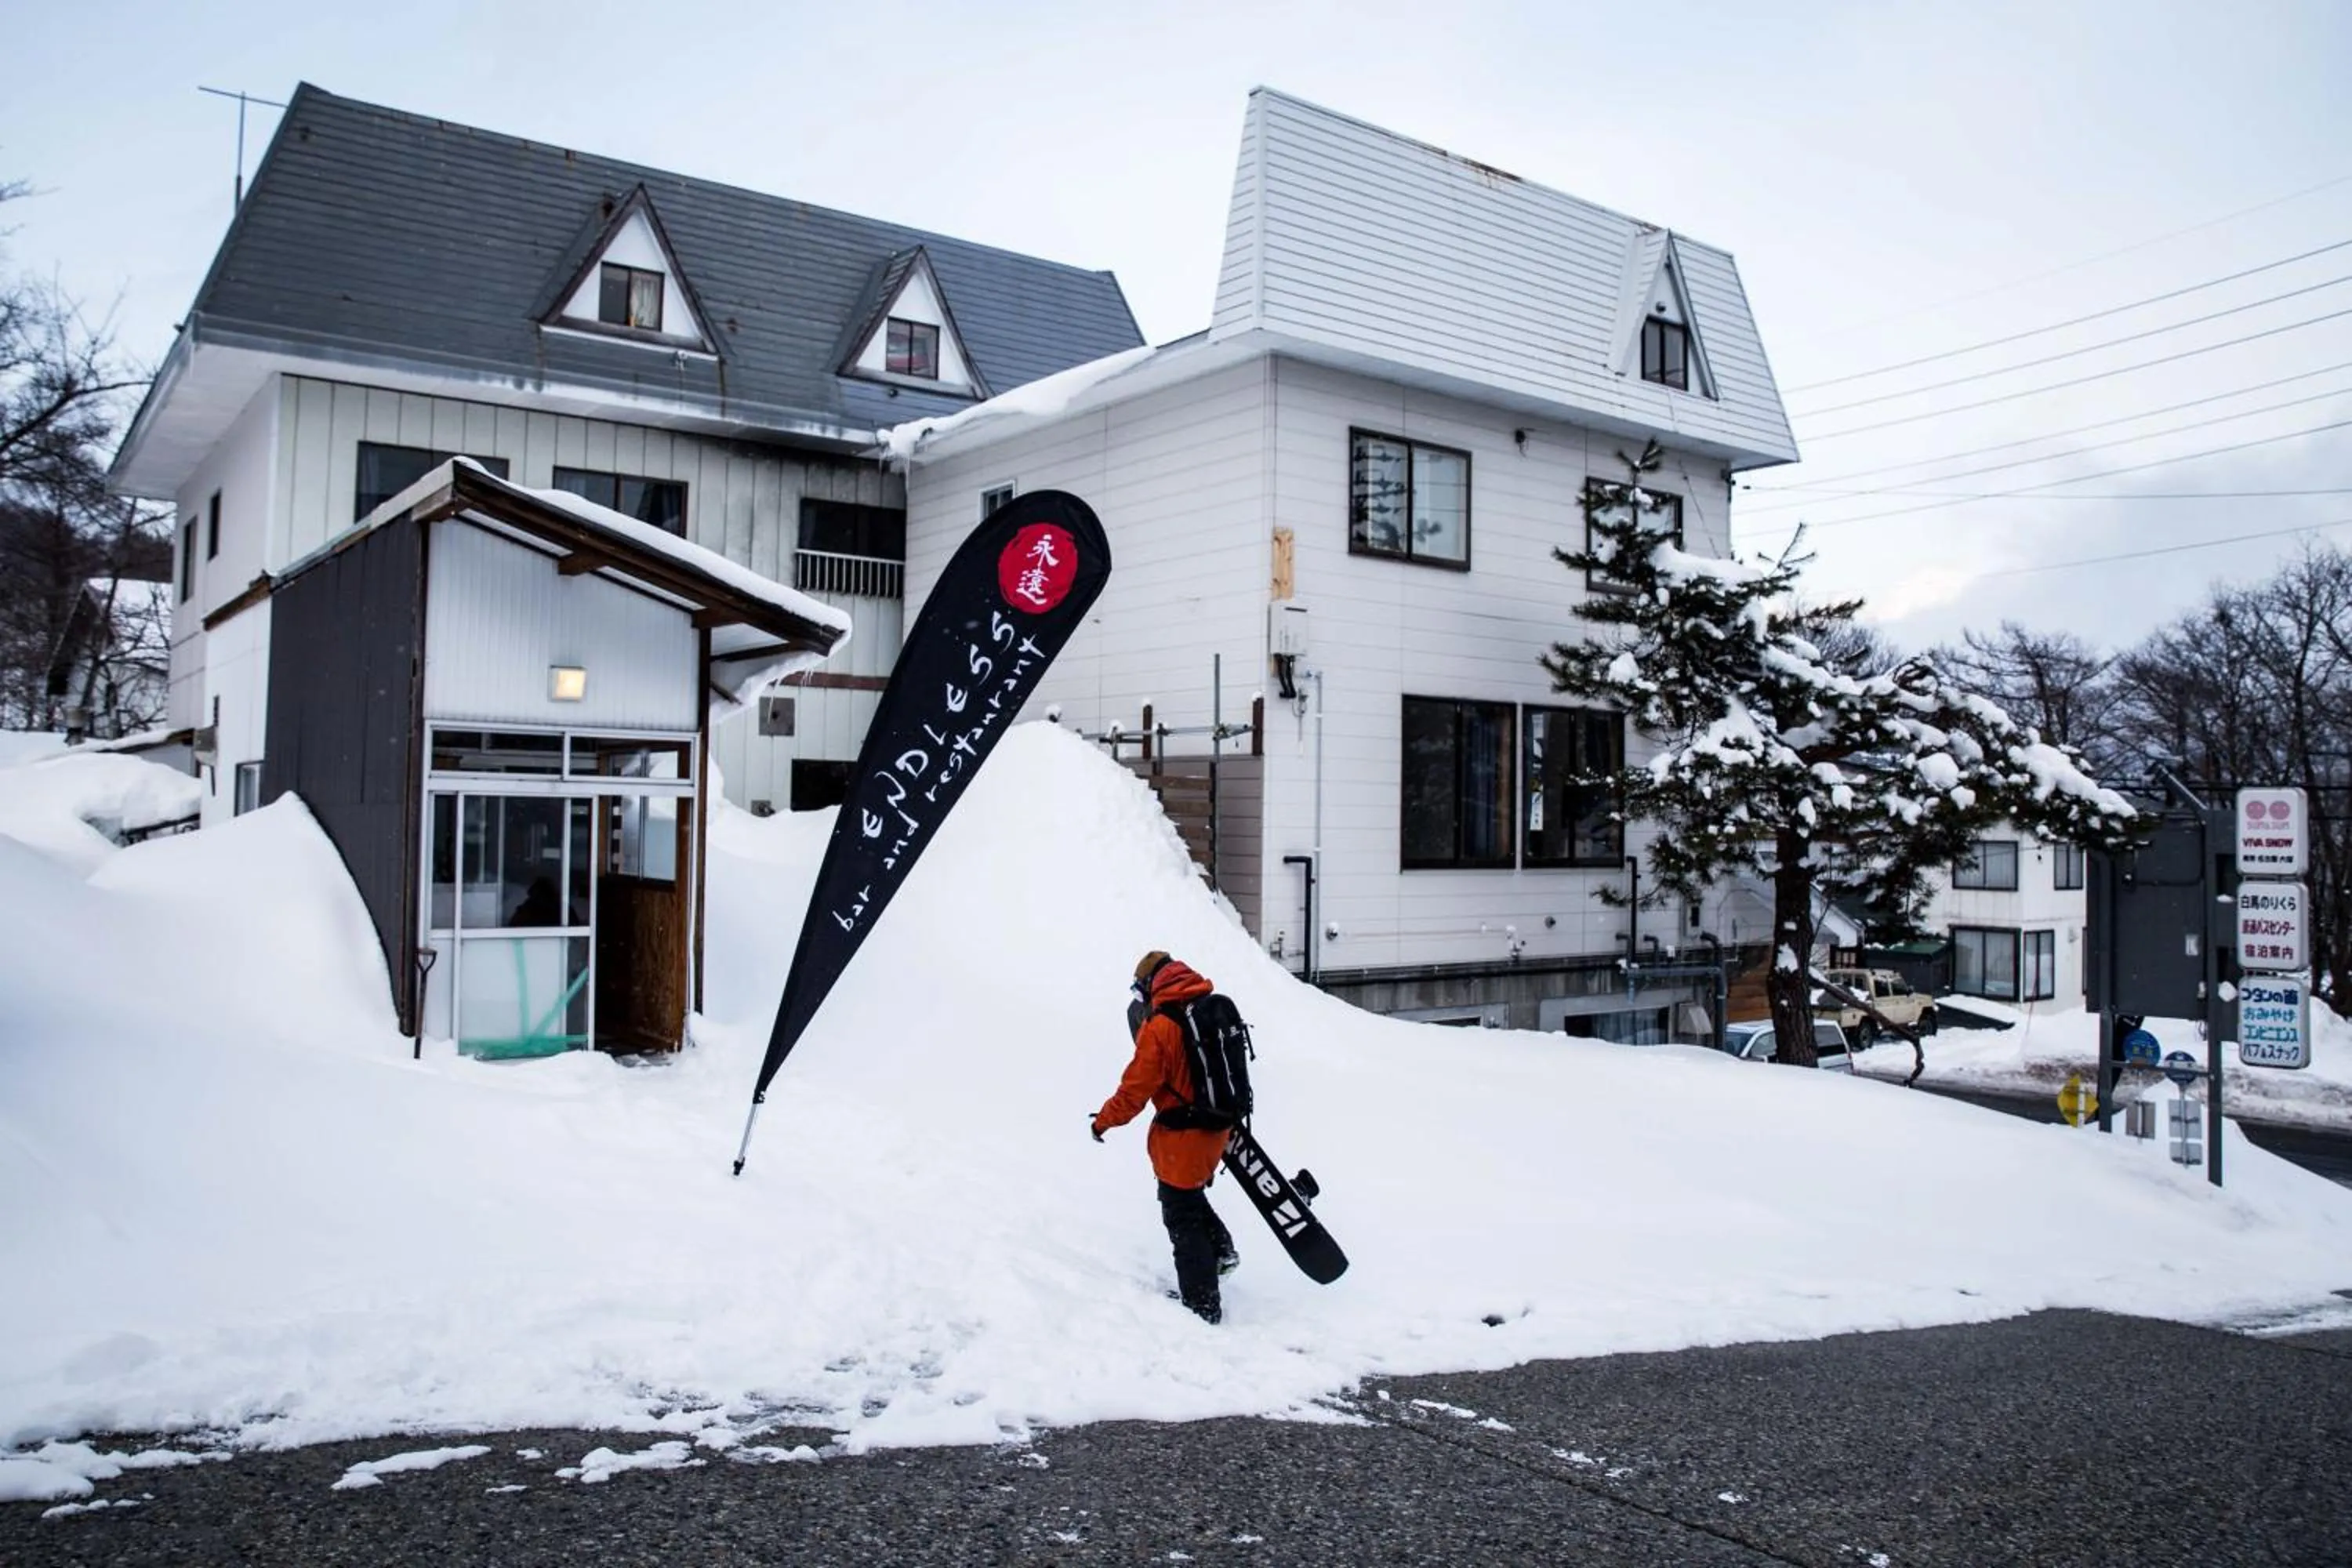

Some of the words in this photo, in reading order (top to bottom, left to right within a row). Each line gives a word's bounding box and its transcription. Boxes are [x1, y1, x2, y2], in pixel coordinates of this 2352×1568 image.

[1015, 533, 1061, 605] 永遠
[833, 885, 873, 932] bar
[883, 814, 920, 871] and
[924, 633, 1047, 802] restaurant
[2240, 895, 2296, 911] 白馬のりくら
[2245, 944, 2293, 960] 宿泊案内
